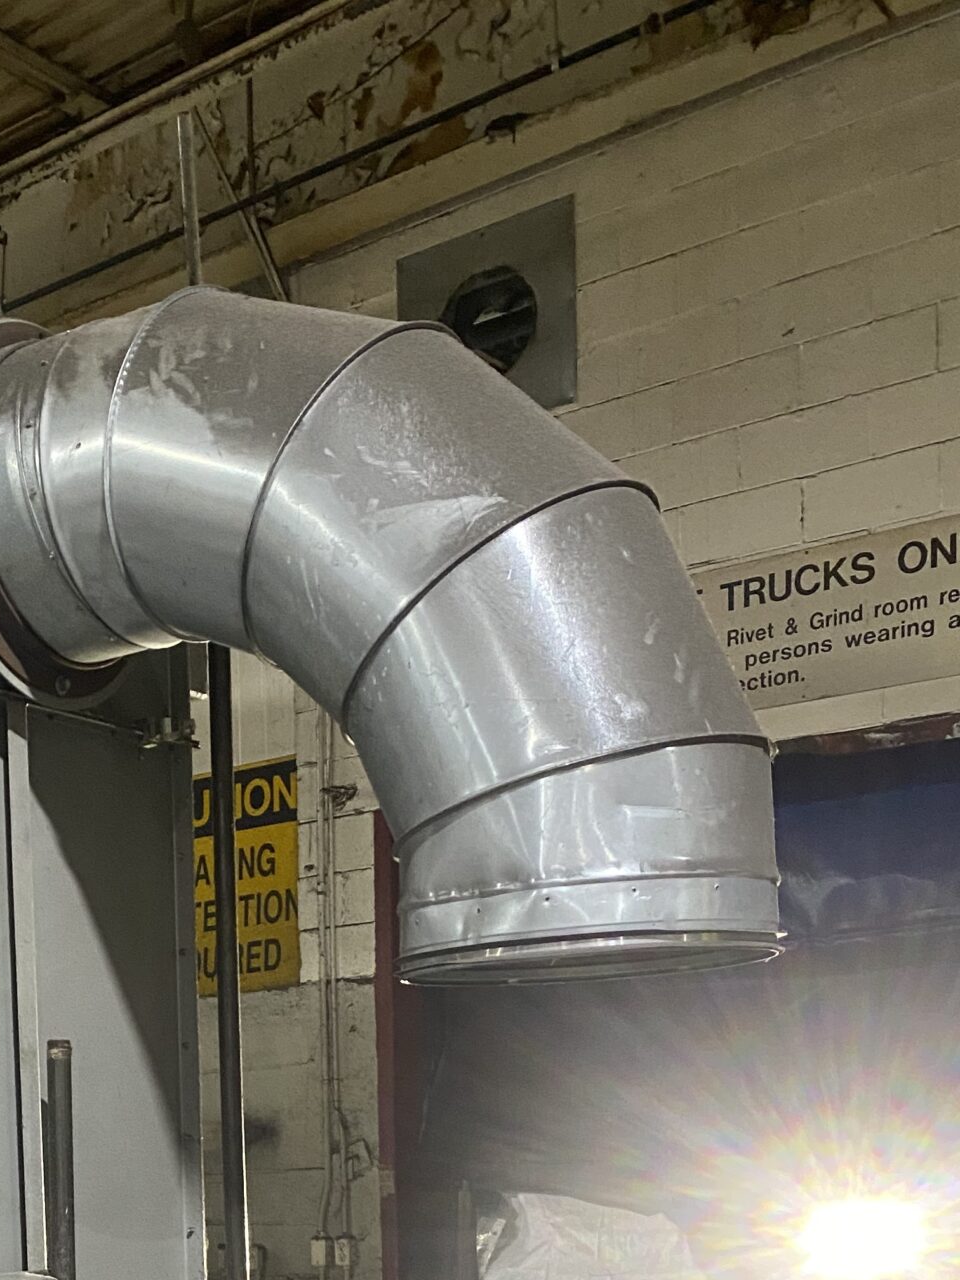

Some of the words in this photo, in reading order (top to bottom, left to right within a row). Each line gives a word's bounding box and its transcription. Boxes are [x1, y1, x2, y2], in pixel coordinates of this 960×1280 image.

[720, 552, 875, 611] TRUCKS
[727, 622, 774, 647] Rivet
[785, 617, 798, 635] &
[809, 605, 863, 630] Grind
[874, 595, 928, 618] room
[745, 638, 832, 671] persons
[845, 619, 935, 648] wearing
